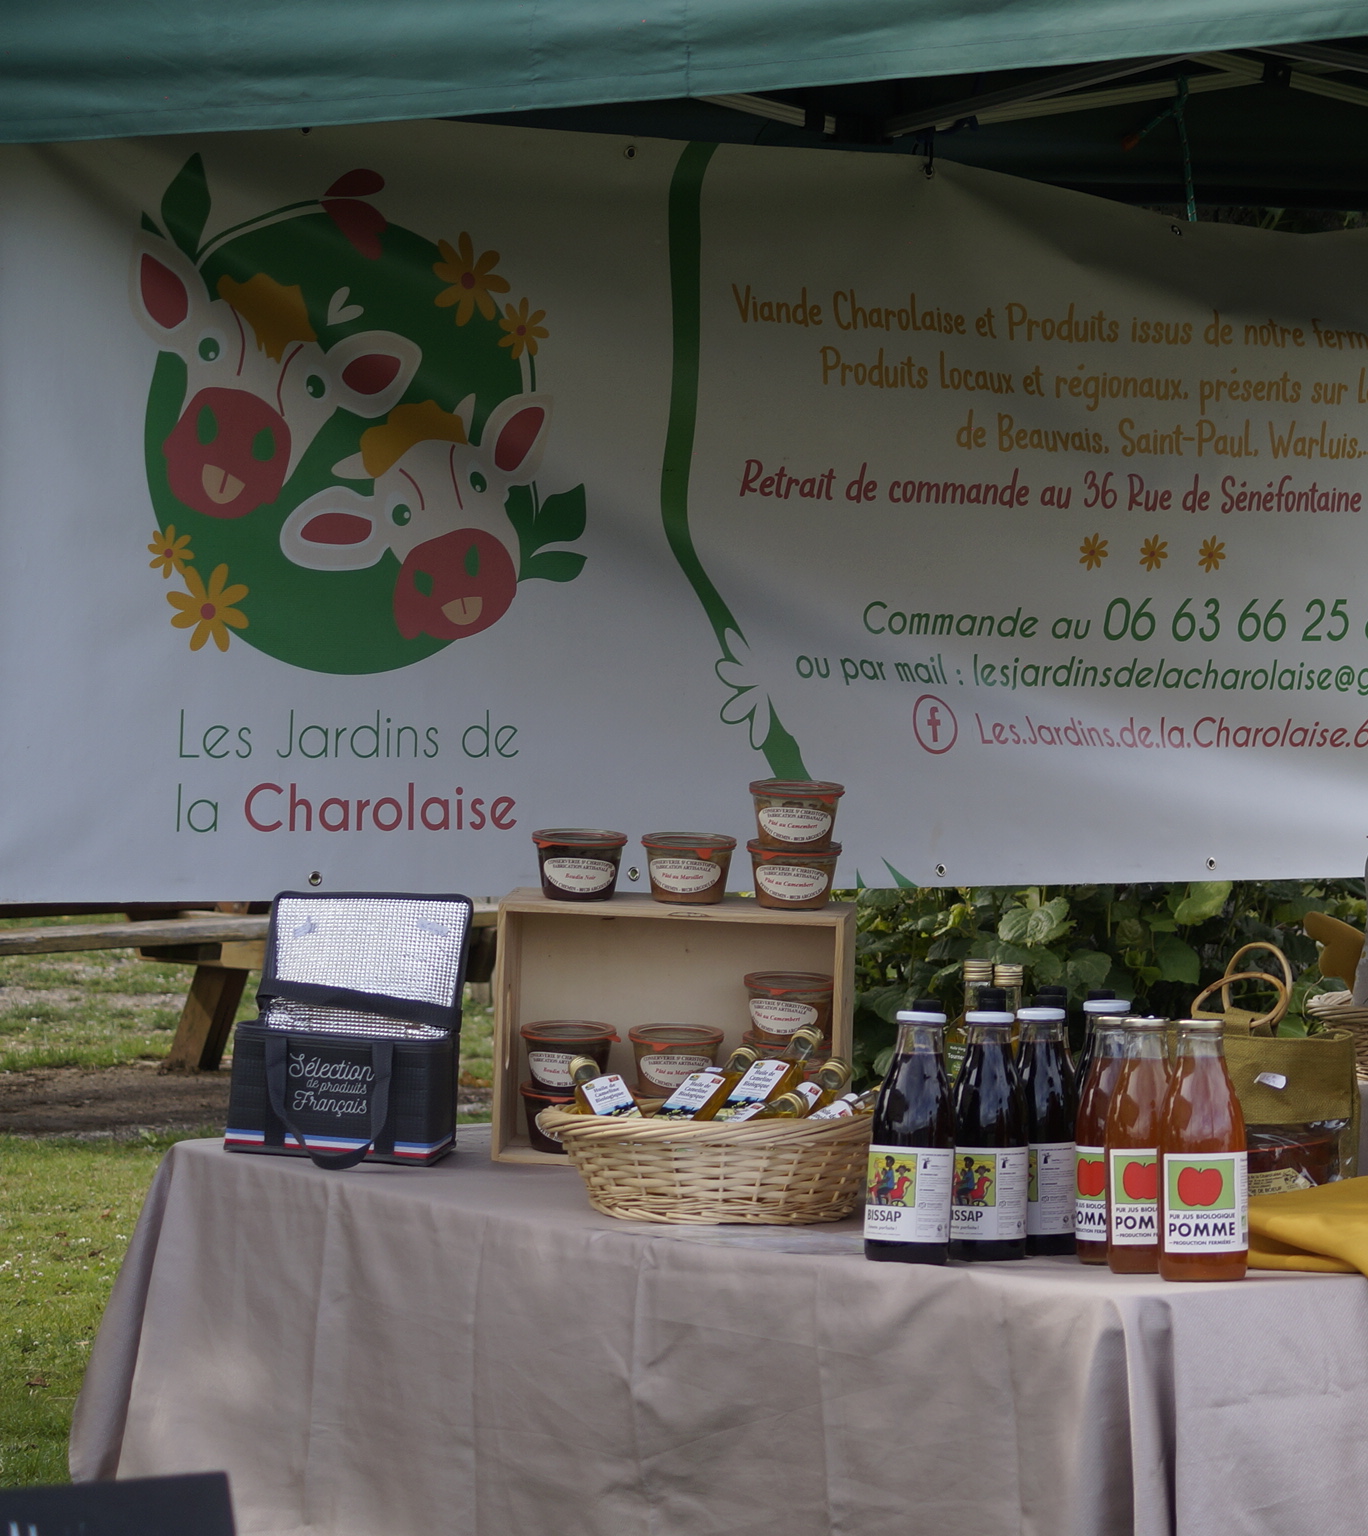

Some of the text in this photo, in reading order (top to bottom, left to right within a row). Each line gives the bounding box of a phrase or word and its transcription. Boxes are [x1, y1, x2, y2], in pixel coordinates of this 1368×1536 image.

[732, 283, 823, 328] Viande
[833, 289, 967, 335] Charolaise
[975, 307, 997, 340] et
[1005, 302, 1119, 343] Produits
[1131, 316, 1192, 345] issus
[1204, 309, 1233, 347] de
[1244, 318, 1305, 349] notre
[820, 346, 928, 390] Produits
[940, 351, 1014, 395] locaux
[1022, 365, 1045, 398] et
[1055, 364, 1189, 412] régionaux,
[1200, 367, 1302, 415] présents
[1311, 380, 1348, 406] sur
[956, 408, 987, 450] de
[997, 412, 1110, 455] Beauvais,
[1118, 417, 1259, 458] Saint-Paul,
[739, 458, 836, 501] Retrait
[845, 462, 877, 503] de
[888, 467, 1030, 508] commande
[1040, 483, 1072, 509] au
[1082, 470, 1118, 510] 36
[1127, 473, 1172, 511] Rue
[1182, 473, 1211, 511] de
[1220, 474, 1361, 514] Sénéfontaine
[862, 600, 1039, 639] Commande
[1051, 616, 1091, 640] au
[1102, 597, 1156, 642] 06
[1171, 597, 1221, 643] 63
[1237, 597, 1287, 643] 66
[1301, 598, 1350, 643] 25
[795, 654, 831, 680] ou
[839, 657, 886, 686] par
[893, 652, 948, 686] mail
[178, 708, 520, 759] Les Jardins de
[176, 782, 518, 833] la Charolaise
[288, 1052, 375, 1082] Sélection
[306, 1077, 368, 1096] de produits
[292, 1089, 368, 1117] Français
[867, 1209, 902, 1222] BISSAP
[1169, 1222, 1236, 1237] POMME
